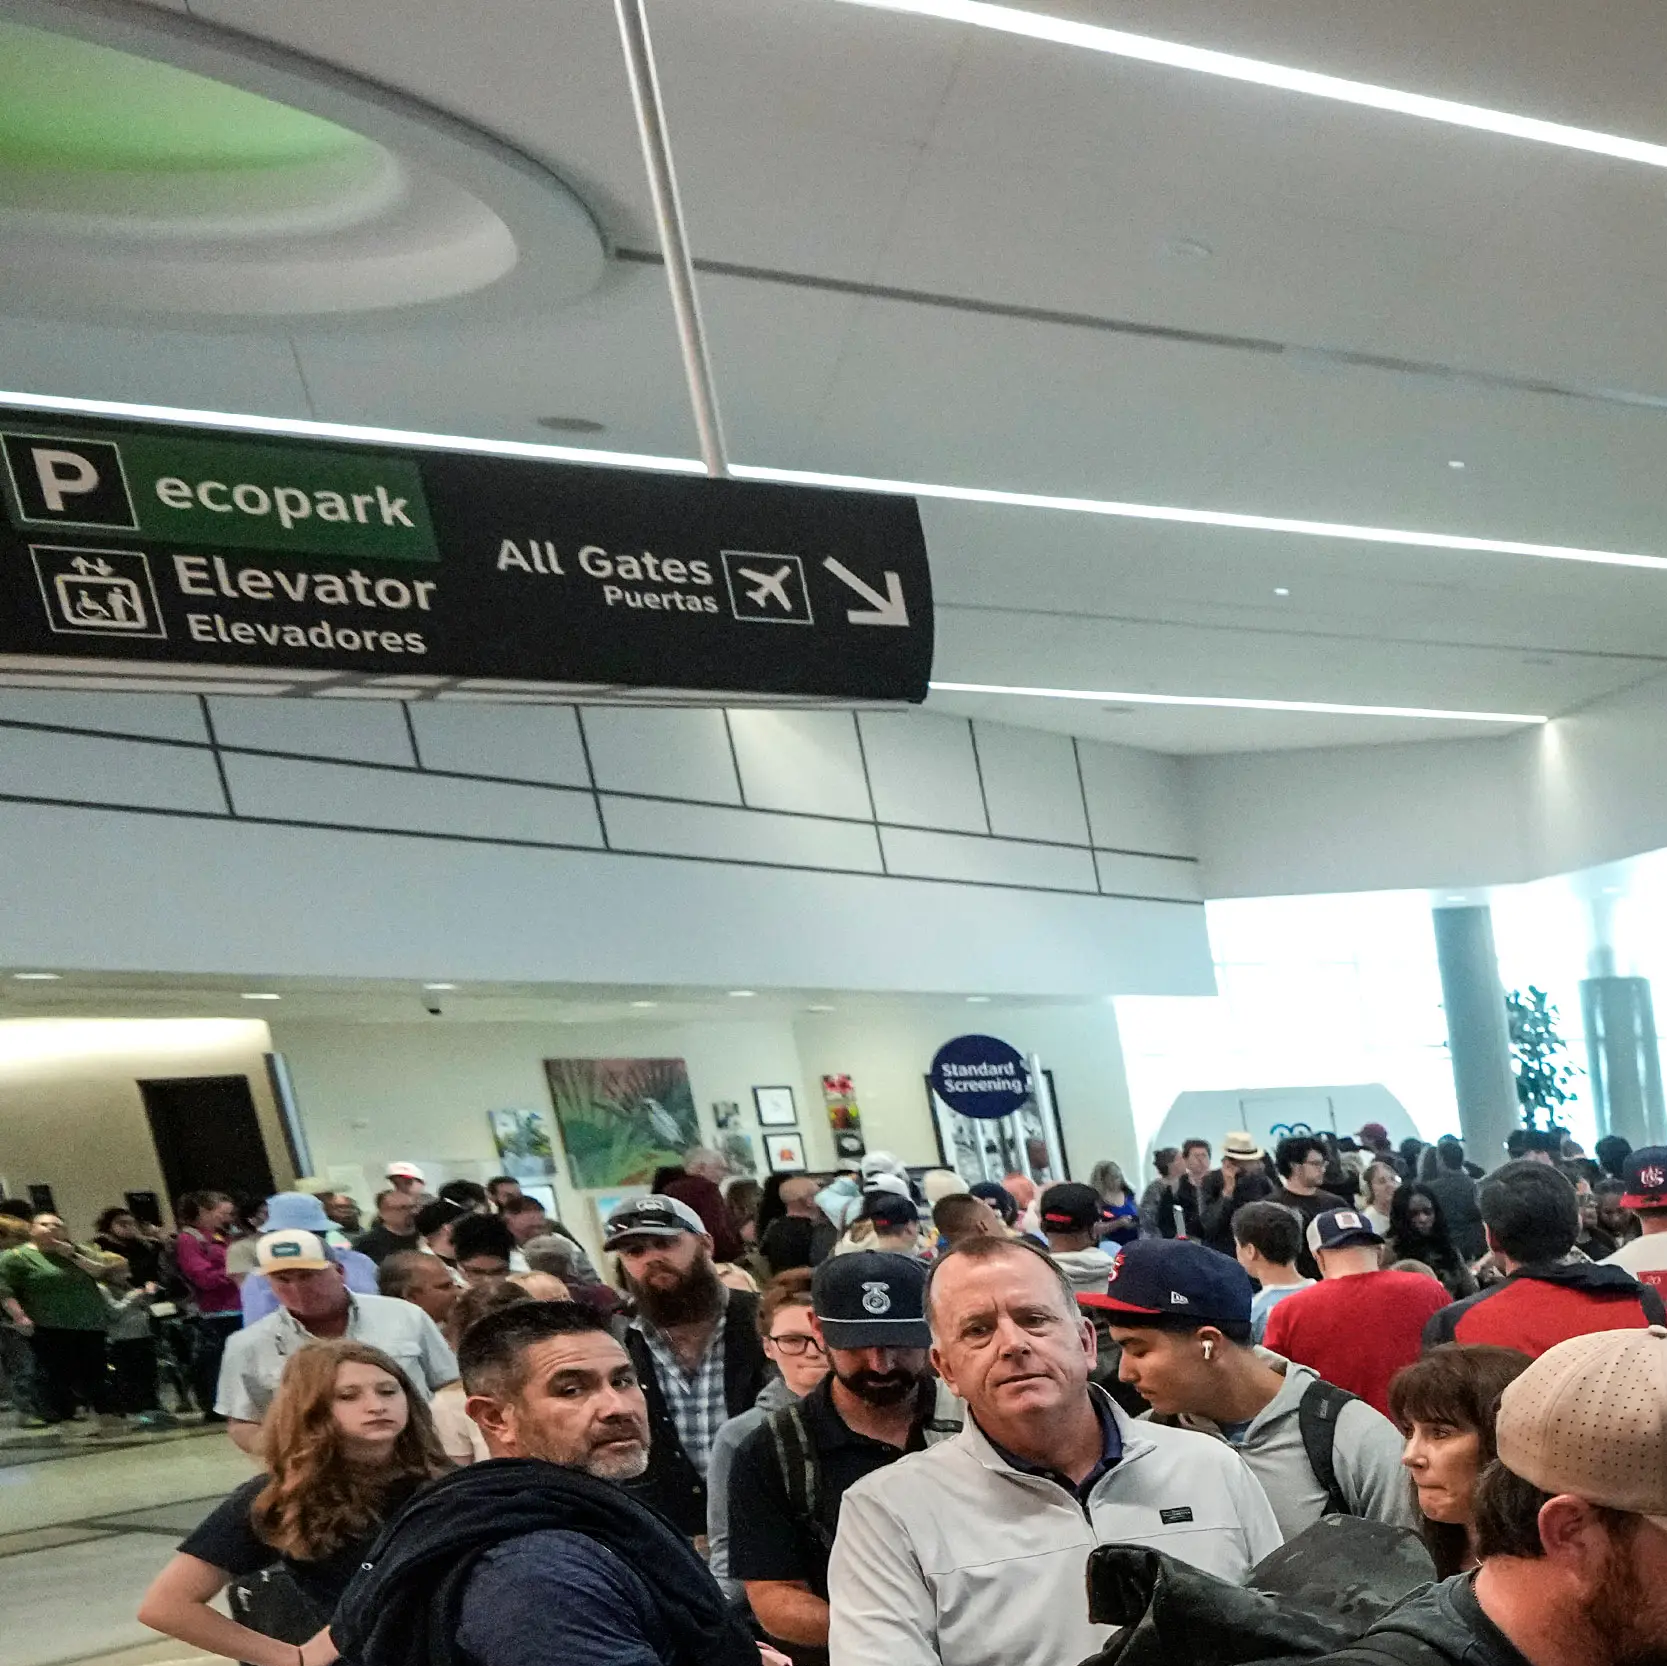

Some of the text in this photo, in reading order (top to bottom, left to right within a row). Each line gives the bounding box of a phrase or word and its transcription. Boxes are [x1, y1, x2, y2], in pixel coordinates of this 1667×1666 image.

[31, 447, 416, 529] P ecopark
[172, 554, 437, 611] Elevator
[497, 538, 714, 586] All Gates
[602, 584, 719, 614] Puertas
[186, 613, 428, 655] Elevadores
[941, 1061, 1016, 1077] Standard
[944, 1078, 1023, 1094] Screening
